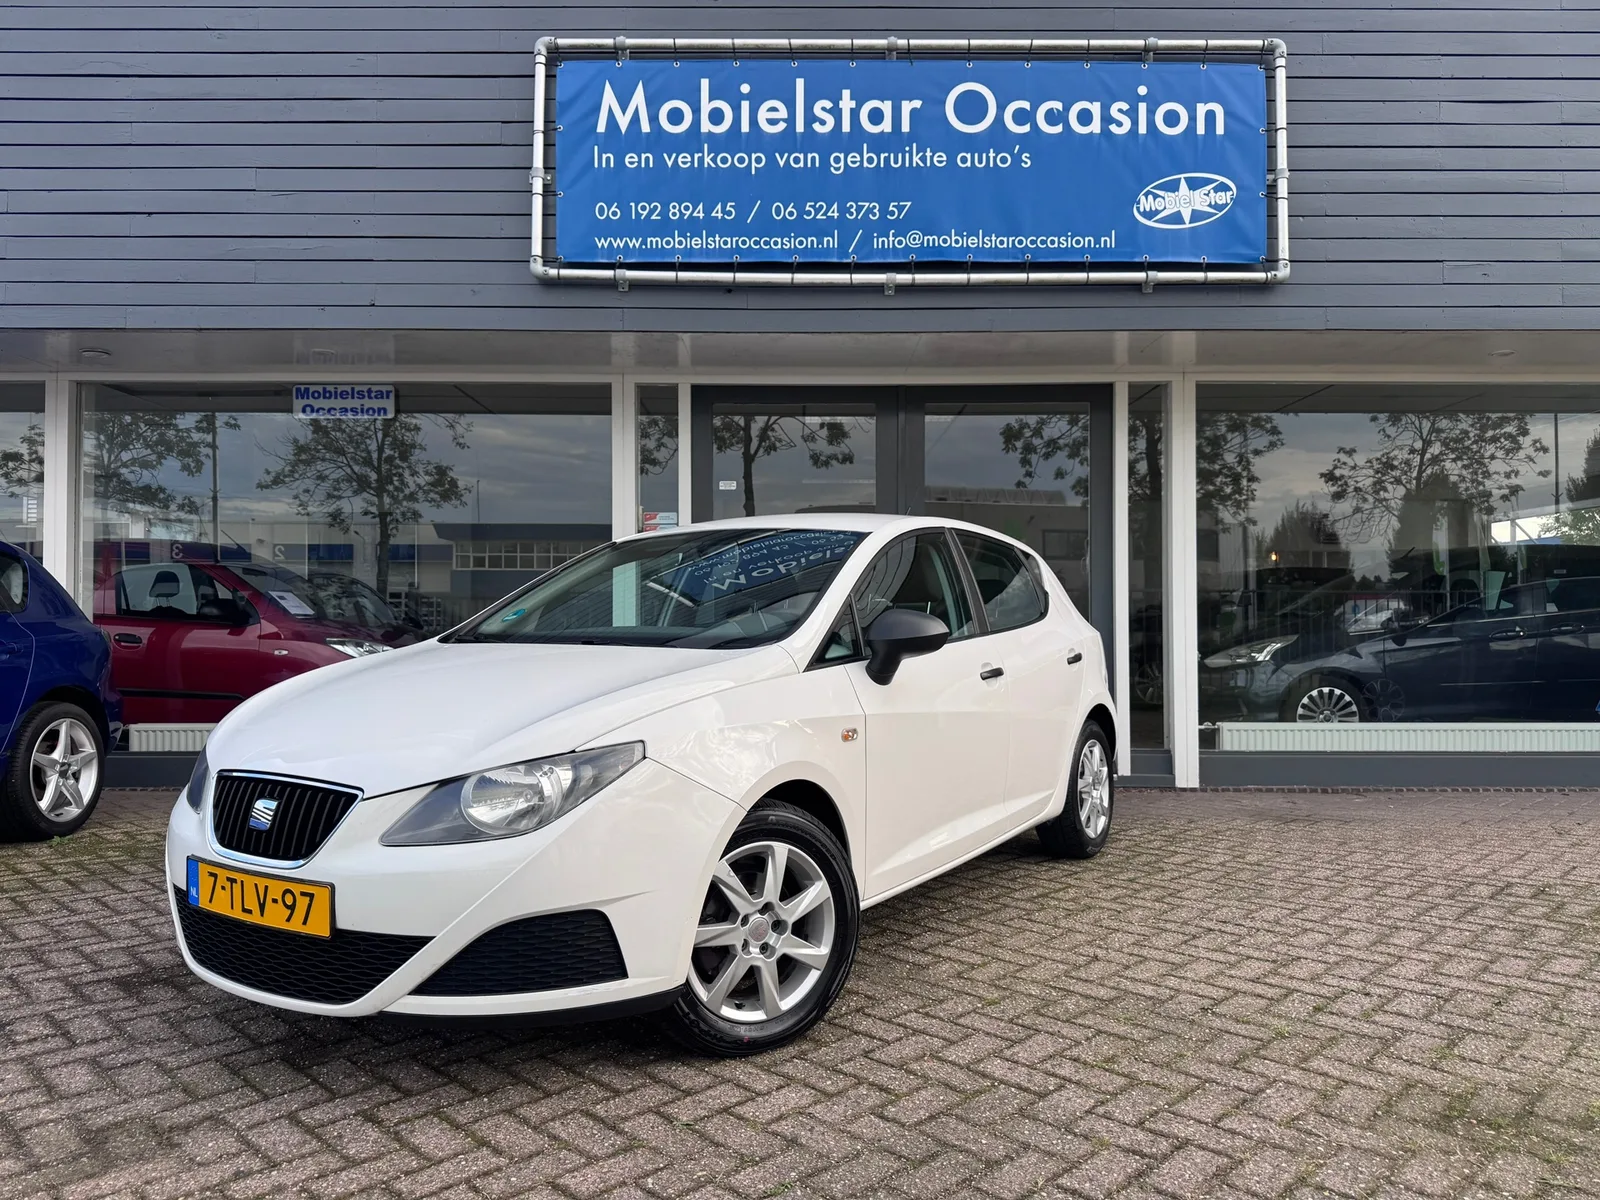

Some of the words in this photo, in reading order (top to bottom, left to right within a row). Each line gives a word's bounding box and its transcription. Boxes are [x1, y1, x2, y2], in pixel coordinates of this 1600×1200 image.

[596, 77, 923, 135] Mobielstar
[945, 81, 1225, 136] Occasion
[594, 145, 614, 168] In
[624, 152, 654, 169] en
[663, 143, 766, 175] verkoop
[775, 152, 820, 168] van
[829, 143, 947, 175] gebruikte
[956, 144, 1032, 168] auto's
[595, 202, 621, 220] 06
[629, 202, 662, 220] 192
[668, 202, 705, 220] 894
[711, 202, 736, 220] 45
[747, 200, 761, 224] /
[771, 202, 797, 220] 06
[804, 202, 840, 220] 524
[846, 202, 880, 220] 373
[887, 202, 912, 220] 57
[1139, 190, 1194, 213] Mobiel
[1199, 189, 1234, 207] Star
[594, 229, 838, 250] www.mobielstaroccasion.nl
[848, 229, 863, 253] /
[873, 229, 1116, 250] info@mobielstaroccasion.nl
[295, 386, 393, 400] Mobielstar
[301, 403, 388, 417] Occasion
[190, 886, 199, 898] NL
[207, 870, 316, 926] 7-TLV-97
